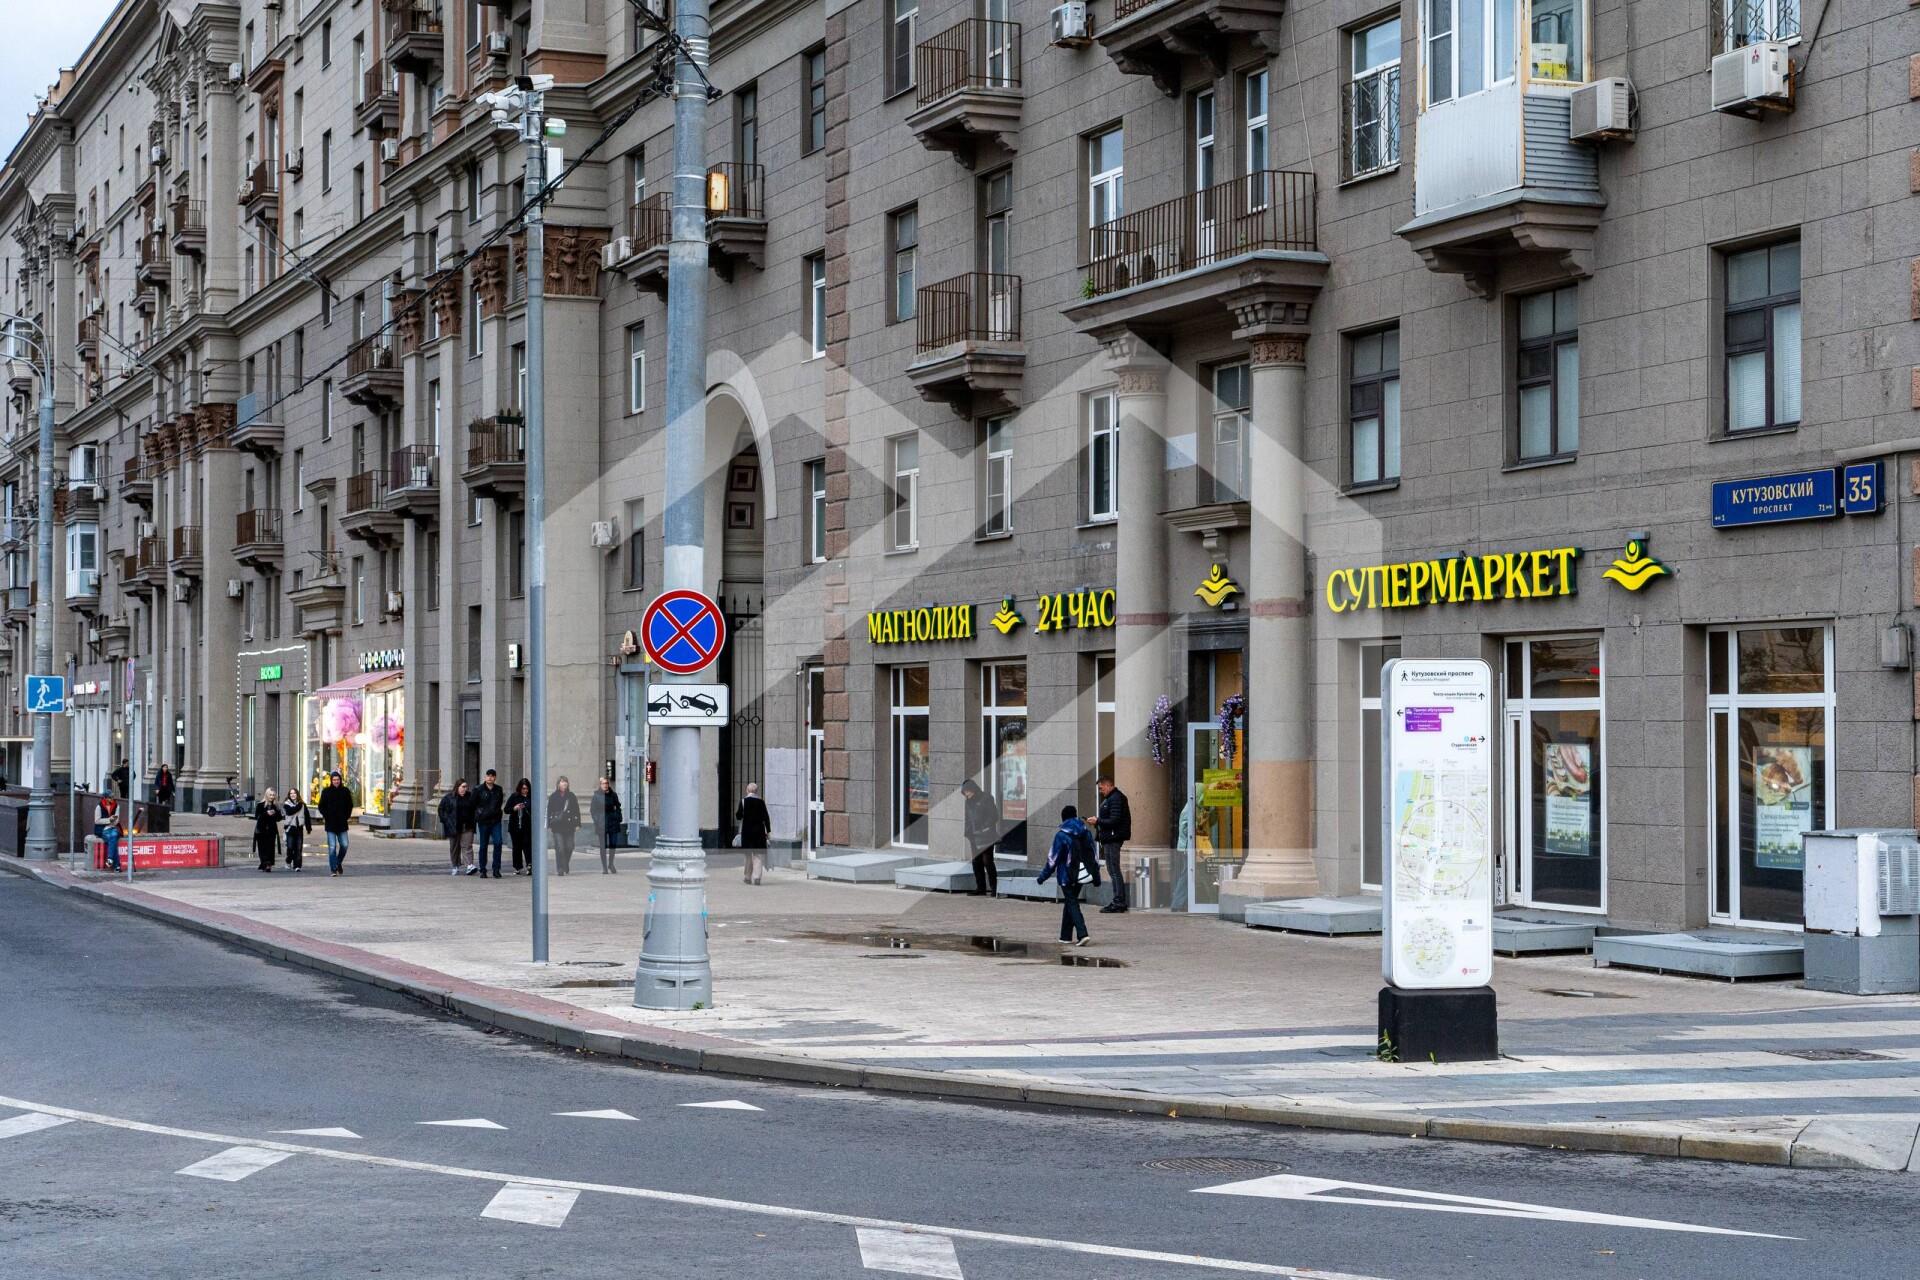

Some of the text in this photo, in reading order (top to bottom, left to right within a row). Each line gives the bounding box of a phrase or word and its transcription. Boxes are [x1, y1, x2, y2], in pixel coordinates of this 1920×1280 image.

[1732, 478, 1814, 505] КУТУЗОВСКИЙ
[1849, 475, 1872, 503] 35
[1753, 503, 1793, 515] ПРОСПЕКТ
[1818, 504, 1826, 512] 71
[1326, 547, 1577, 613] СУПЕРМАРКЕТ
[867, 604, 971, 643] МАГНОЛИЯ
[1038, 594, 1064, 632] 24
[1411, 670, 1447, 678] Кутузовский
